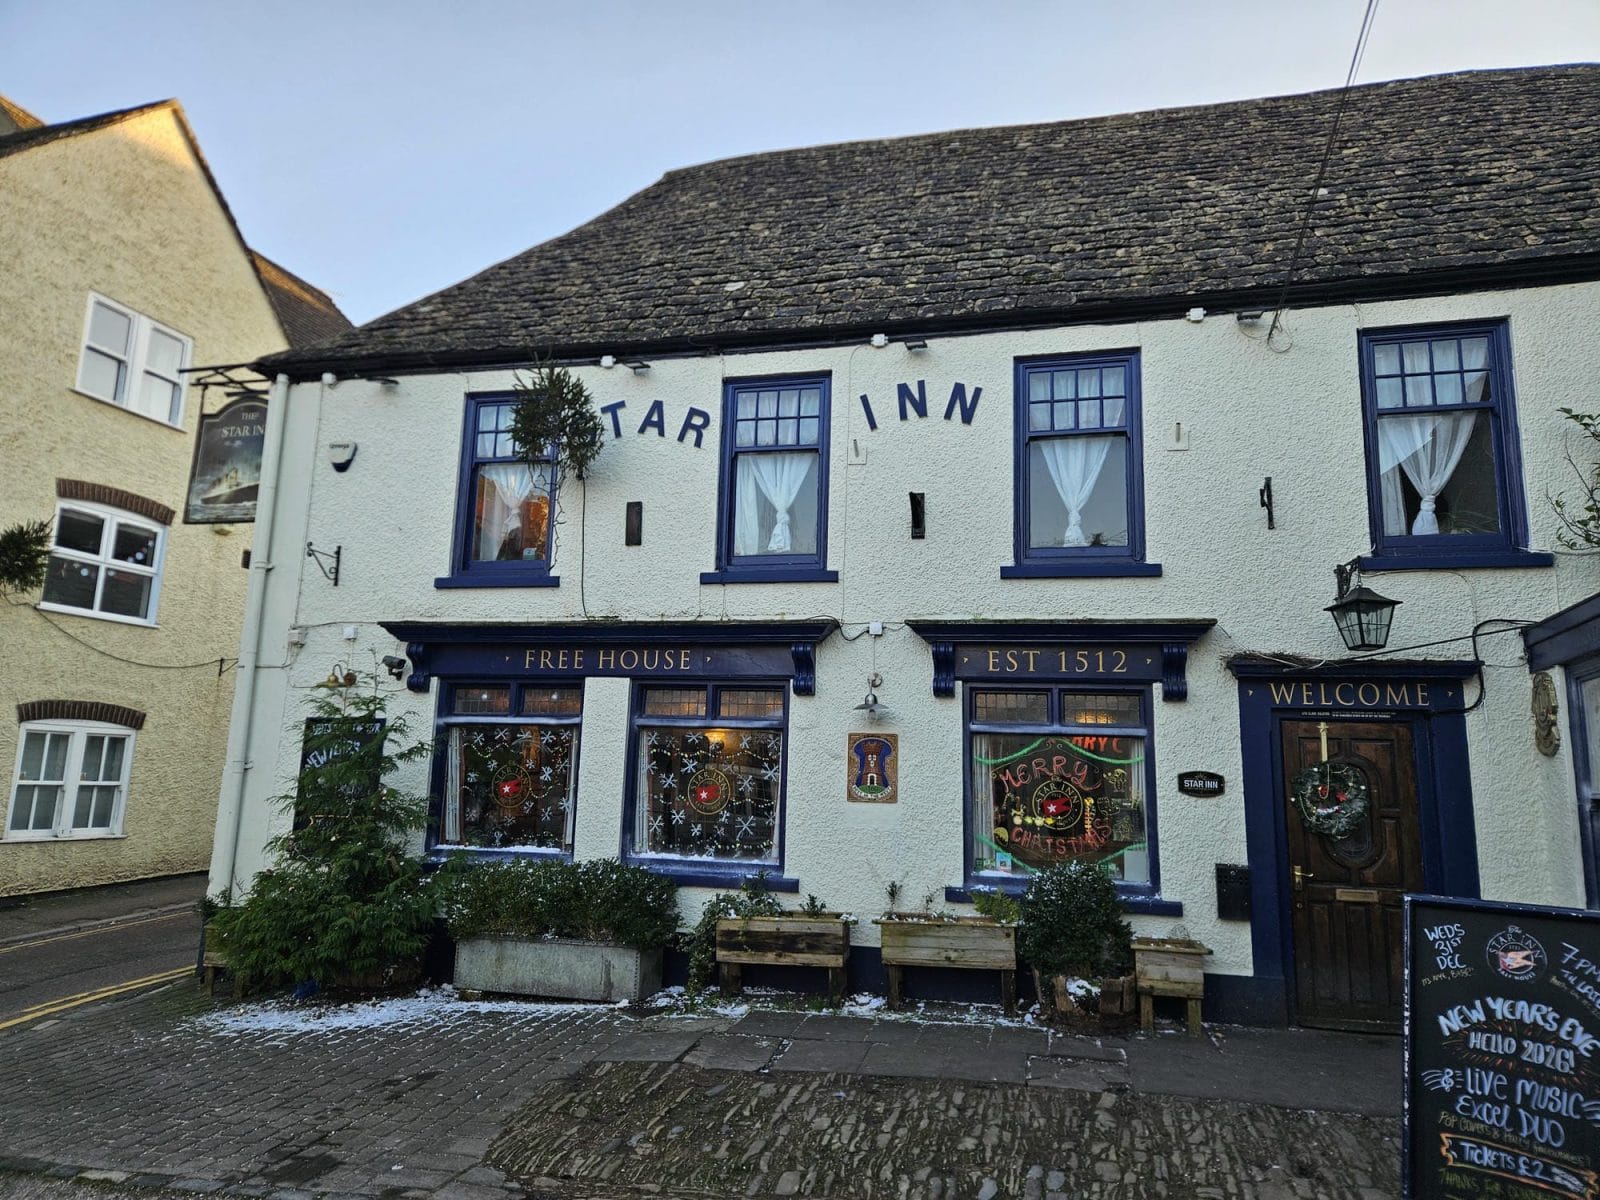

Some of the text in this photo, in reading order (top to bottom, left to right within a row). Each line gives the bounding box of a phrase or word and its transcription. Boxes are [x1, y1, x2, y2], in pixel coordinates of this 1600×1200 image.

[241, 412, 259, 420] THE
[601, 379, 983, 449] TAR INN
[221, 424, 265, 438] STAR IN
[524, 649, 691, 670] FREE HOUSE
[987, 650, 1127, 673] EST 1512
[1268, 682, 1430, 706] WELCOME
[999, 755, 1102, 792] MERRY
[1183, 779, 1218, 789] STAR INN
[1060, 783, 1080, 804] INN
[1010, 818, 1112, 855] CHRISTMAS
[1423, 923, 1466, 942] WEDS
[1434, 937, 1463, 956] 31ST
[1489, 933, 1543, 958] STAR INN
[1436, 953, 1467, 970] DEC
[1437, 999, 1487, 1037] NEW
[1486, 995, 1561, 1032] YEAR'S
[1558, 1017, 1600, 1058] EVE
[1468, 1031, 1576, 1075] HELLO 2026!
[1516, 1078, 1584, 1120] MUSIC
[1518, 1107, 1566, 1148] DUO
[1458, 1140, 1516, 1170] TICKETS
